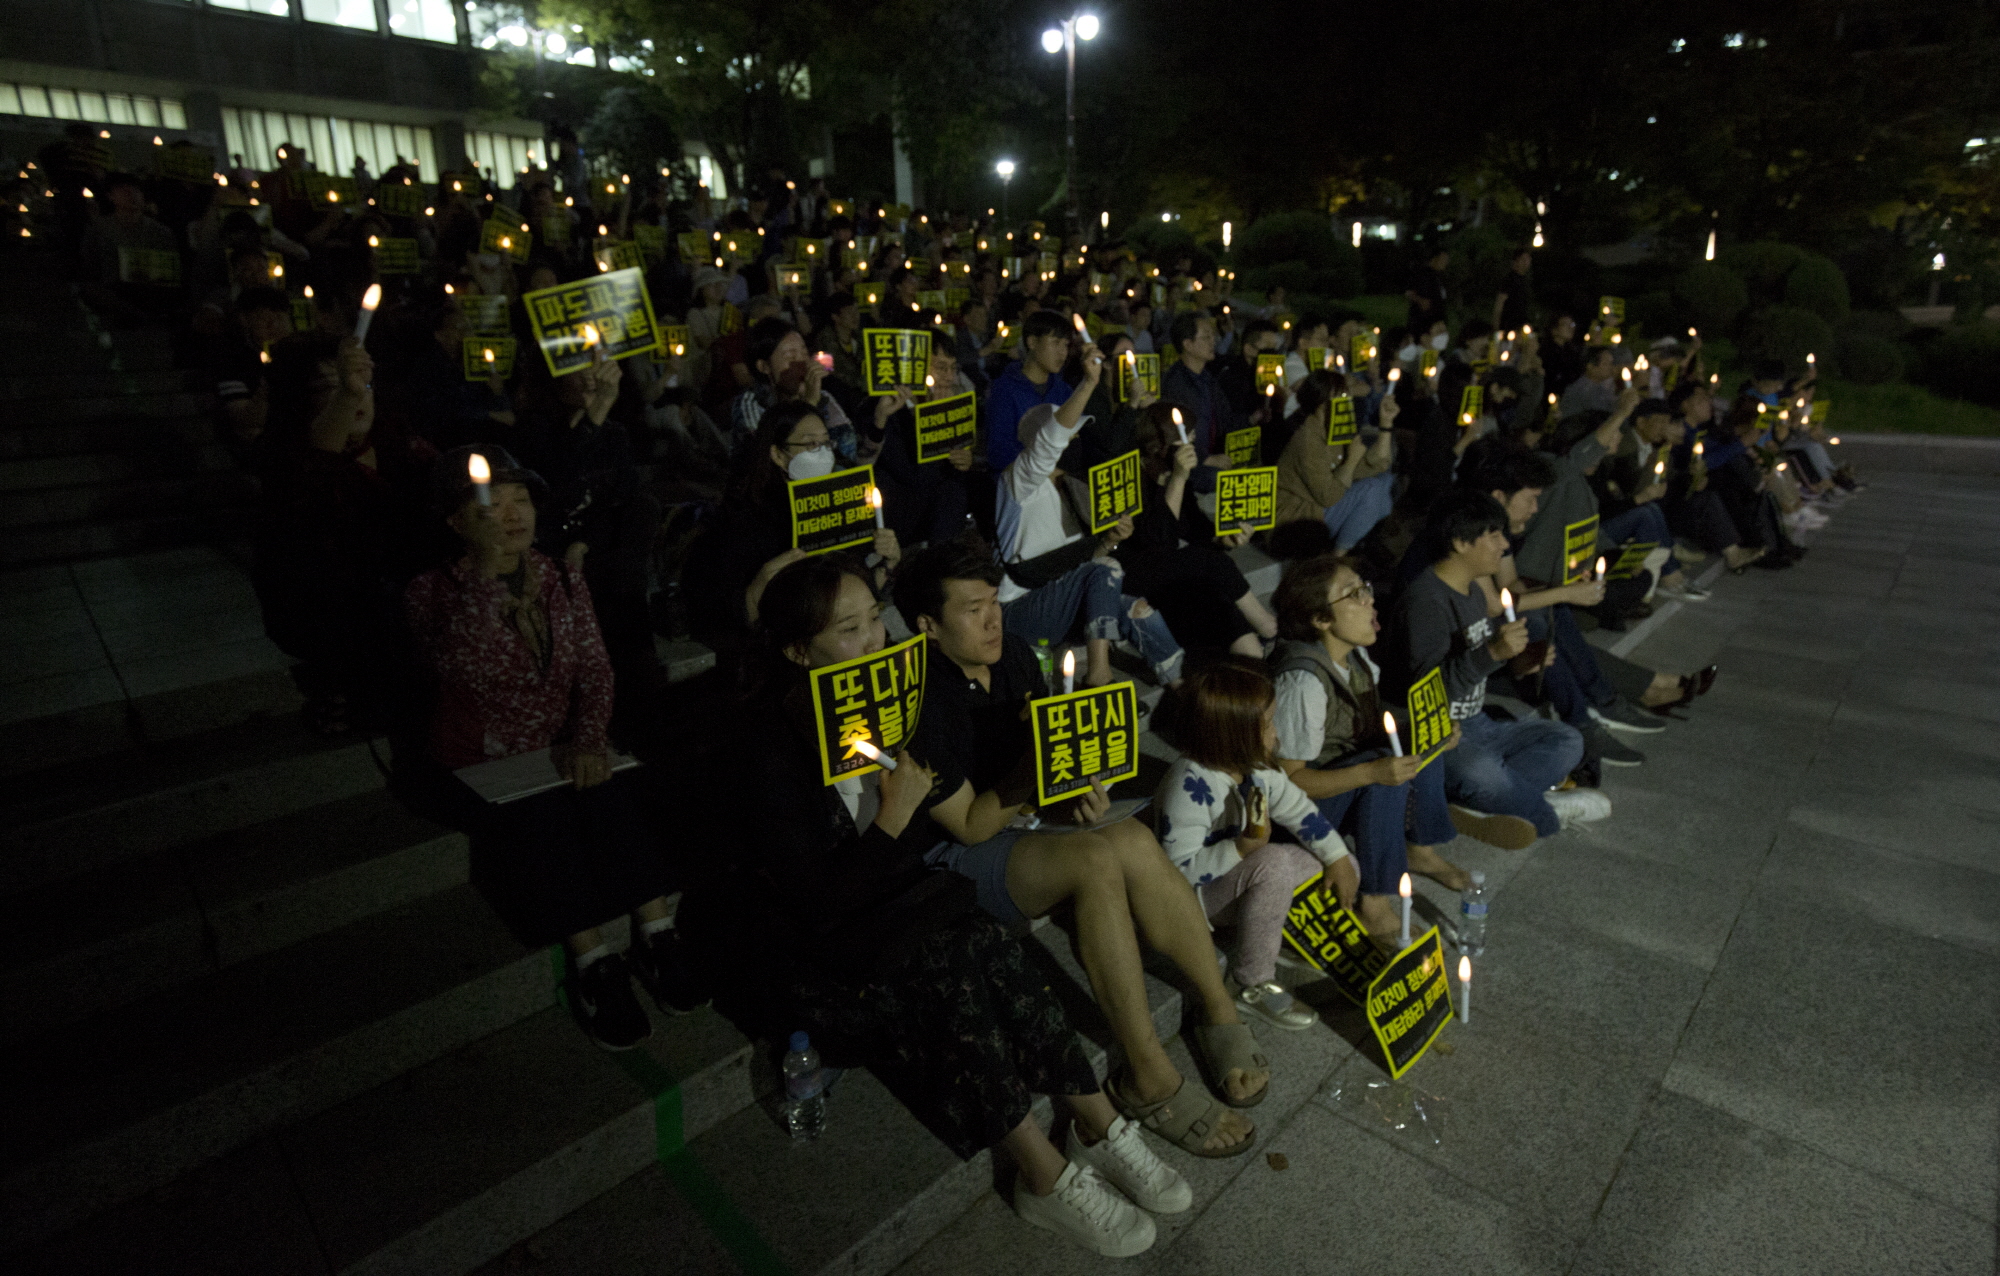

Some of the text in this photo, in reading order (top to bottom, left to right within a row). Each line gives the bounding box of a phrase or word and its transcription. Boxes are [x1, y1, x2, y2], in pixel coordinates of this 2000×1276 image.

[874, 334, 927, 358] 또다시
[876, 359, 926, 385] 촛불을
[1097, 457, 1135, 495] 또다시
[1220, 472, 1273, 499] 강남양파
[795, 492, 831, 514] 이것이
[797, 502, 876, 536] 대답하라 문재인
[1098, 482, 1136, 520] 촛불을
[1220, 496, 1272, 522] 조국파면
[832, 646, 919, 716] 또다시
[838, 688, 920, 761] 촛불을
[1047, 691, 1127, 743] 또다시
[1050, 729, 1128, 785] 촛불을
[1370, 979, 1409, 1018] 이것이
[1381, 998, 1426, 1046] 대답하라
